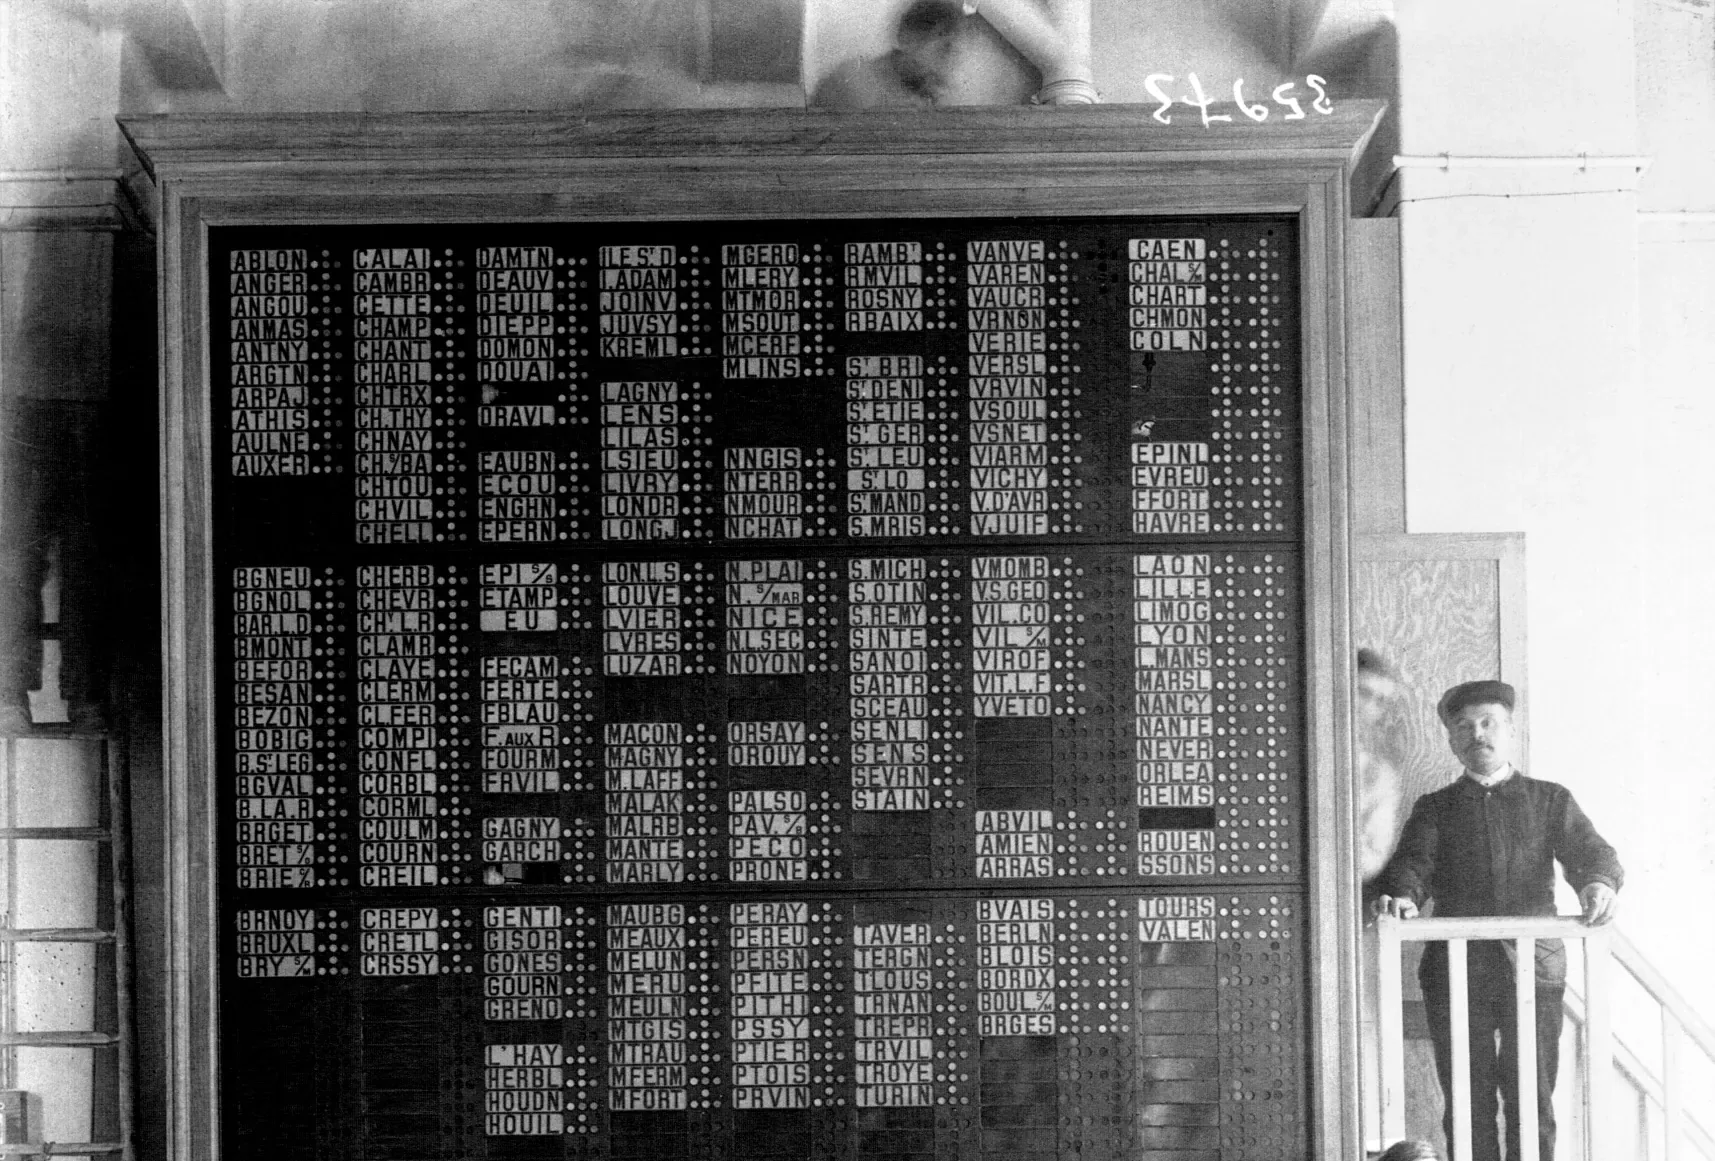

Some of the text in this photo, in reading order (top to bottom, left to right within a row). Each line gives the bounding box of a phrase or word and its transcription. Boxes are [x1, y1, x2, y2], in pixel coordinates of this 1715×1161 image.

[357, 249, 427, 268] CALAI
[479, 248, 550, 267] DAMTN
[971, 242, 1041, 261] VANVE
[1137, 240, 1196, 259] CAEN
[725, 268, 795, 287] MLERY
[848, 266, 917, 285] RMVIL
[973, 265, 1041, 284] VAREN
[480, 293, 549, 312] DEUIL
[603, 292, 671, 311] JOINV
[848, 289, 918, 308] ROSNY
[972, 287, 1042, 306] VAUCR
[1132, 285, 1201, 304] CHART
[235, 296, 305, 315] ANGOU
[357, 295, 428, 314] CETTE
[480, 316, 550, 335] DIEPP
[849, 312, 918, 331] RBAIX
[1133, 308, 1203, 327] CHMON
[481, 339, 551, 358] DOMON
[972, 332, 1041, 351] VERIE
[1133, 331, 1203, 350] COLN
[236, 342, 304, 361] ANTNY
[481, 362, 551, 381] DOUAI
[727, 358, 797, 377] MLINS
[973, 355, 1041, 374] VERSL
[236, 365, 305, 384] ARGTN
[236, 387, 306, 406] ARPAJ
[604, 382, 674, 401] LAGNY
[974, 378, 1043, 397] VRVIN
[236, 410, 305, 429] ATHIS
[481, 406, 550, 425] DRAVL
[604, 405, 674, 424] LENS
[358, 431, 428, 450] CHNAY
[604, 428, 675, 447] LILAS
[973, 423, 1043, 442] VSNET
[482, 452, 552, 471] EAUBN
[605, 450, 675, 469] LSIEU
[727, 448, 798, 467] NNGIS
[974, 446, 1044, 465] VIARM
[1136, 444, 1204, 463] EPINL
[236, 456, 306, 475] AUXER
[482, 475, 552, 494] ECOU
[605, 473, 674, 492] LIVRY
[975, 469, 1043, 488] VICHY
[1135, 467, 1205, 486] EVREU
[482, 498, 552, 517] ENGHN
[605, 496, 675, 515] LONDR
[728, 495, 798, 514] NMOUR
[1136, 490, 1205, 509] FFORT
[359, 500, 428, 519] CHVIL
[482, 522, 553, 541] EPERN
[728, 518, 798, 537] NCHAT
[975, 515, 1044, 534] VJUIF
[1136, 513, 1206, 532] HAVRE
[975, 558, 1045, 577] VMOMB
[1137, 556, 1207, 575] LAON
[360, 566, 430, 585] CHERB
[483, 588, 554, 607] ETAMP
[606, 586, 676, 605] LOUVE
[1137, 579, 1207, 598] LILLE
[237, 591, 306, 610] BGNOL
[505, 611, 539, 630] EU
[606, 609, 677, 628] LVIER
[729, 607, 798, 626] NICE
[1137, 602, 1208, 621] LIMOG
[607, 632, 678, 651] LVRES
[853, 629, 923, 648] SINTE
[1138, 625, 1208, 644] LYON
[238, 638, 308, 657] BMONT
[361, 636, 431, 655] CLAMR
[361, 659, 432, 678] CLAYE
[484, 657, 555, 676] FECAM
[607, 656, 678, 675] LUZAR
[730, 654, 801, 673] NOYON
[853, 652, 924, 671] SANOI
[977, 650, 1045, 669] VIROF
[238, 661, 308, 680] BEFOR
[484, 680, 555, 699] FERTE
[854, 675, 925, 694] SARTR
[1138, 671, 1207, 690] MARSL
[361, 682, 432, 701] CLERM
[485, 703, 555, 722] FBLAU
[854, 698, 925, 717] SCEAU
[978, 697, 1048, 716] YVETO
[238, 707, 309, 726] BEZON
[608, 724, 678, 743] MACON
[731, 723, 801, 742] ORSAY
[854, 721, 925, 740] SENLI
[1139, 717, 1209, 736] NANTE
[239, 730, 309, 749] BOBIG
[362, 728, 432, 747] COMPI
[362, 751, 431, 770] CONFL
[485, 749, 556, 768] FOURM
[608, 747, 679, 766] MAGNY
[731, 746, 802, 765] OROUY
[855, 744, 925, 763] SENS
[239, 776, 308, 795] BGVAL
[362, 774, 431, 793] CORBL
[485, 772, 554, 791] FRVIL
[855, 767, 926, 786] SEVRN
[609, 794, 678, 813] MALAK
[732, 792, 803, 811] PALSO
[855, 790, 926, 809] STAIN
[1140, 786, 1211, 805] REIMS
[363, 797, 432, 816] CORML
[363, 820, 433, 839] COULM
[486, 818, 556, 837] GAGNY
[609, 817, 680, 836] MALRB
[982, 811, 1048, 830] ABVIL
[240, 822, 309, 841] BRGET
[609, 840, 680, 859] MANTE
[732, 838, 803, 857] PECO
[981, 834, 1050, 853] AMIEN
[1141, 832, 1212, 851] ROUEN
[363, 843, 434, 862] COURN
[486, 842, 557, 861] GARCH
[364, 866, 433, 885] CREIL
[610, 863, 680, 882] MARLY
[733, 861, 804, 880] PRONE
[980, 858, 1050, 877] ARRAS
[487, 907, 557, 926] GENTI
[610, 906, 681, 925] MAUBG
[734, 904, 803, 923] PERAY
[980, 900, 1051, 919] BVAIS
[1141, 898, 1213, 917] TOURS
[240, 911, 309, 930] BRNOY
[364, 909, 434, 928] CREPY
[611, 929, 679, 948] MEAUX
[734, 927, 805, 946] PEREU
[857, 925, 928, 944] TAVER
[1143, 921, 1213, 940] VALEN
[364, 932, 433, 951] CRETL
[487, 931, 558, 950] GISOR
[364, 955, 434, 974] CRSSY
[611, 952, 682, 971] MELUN
[611, 975, 682, 994] MERU
[734, 973, 805, 992] PFITE
[981, 969, 1050, 988] BORDX
[735, 996, 806, 1015] PITHI
[858, 994, 929, 1013] TRNAN
[735, 1019, 803, 1038] PSSY
[612, 1044, 683, 1063] MTRAU
[735, 1042, 806, 1061] PTIER
[859, 1040, 928, 1059] TRVIL
[488, 1069, 557, 1088] HERBL
[736, 1065, 807, 1084] PTOIS
[489, 1092, 559, 1111] HOUDN
[612, 1090, 682, 1109] MFORT
[736, 1088, 807, 1107] PRVIN
[489, 1115, 558, 1134] HOUIL
